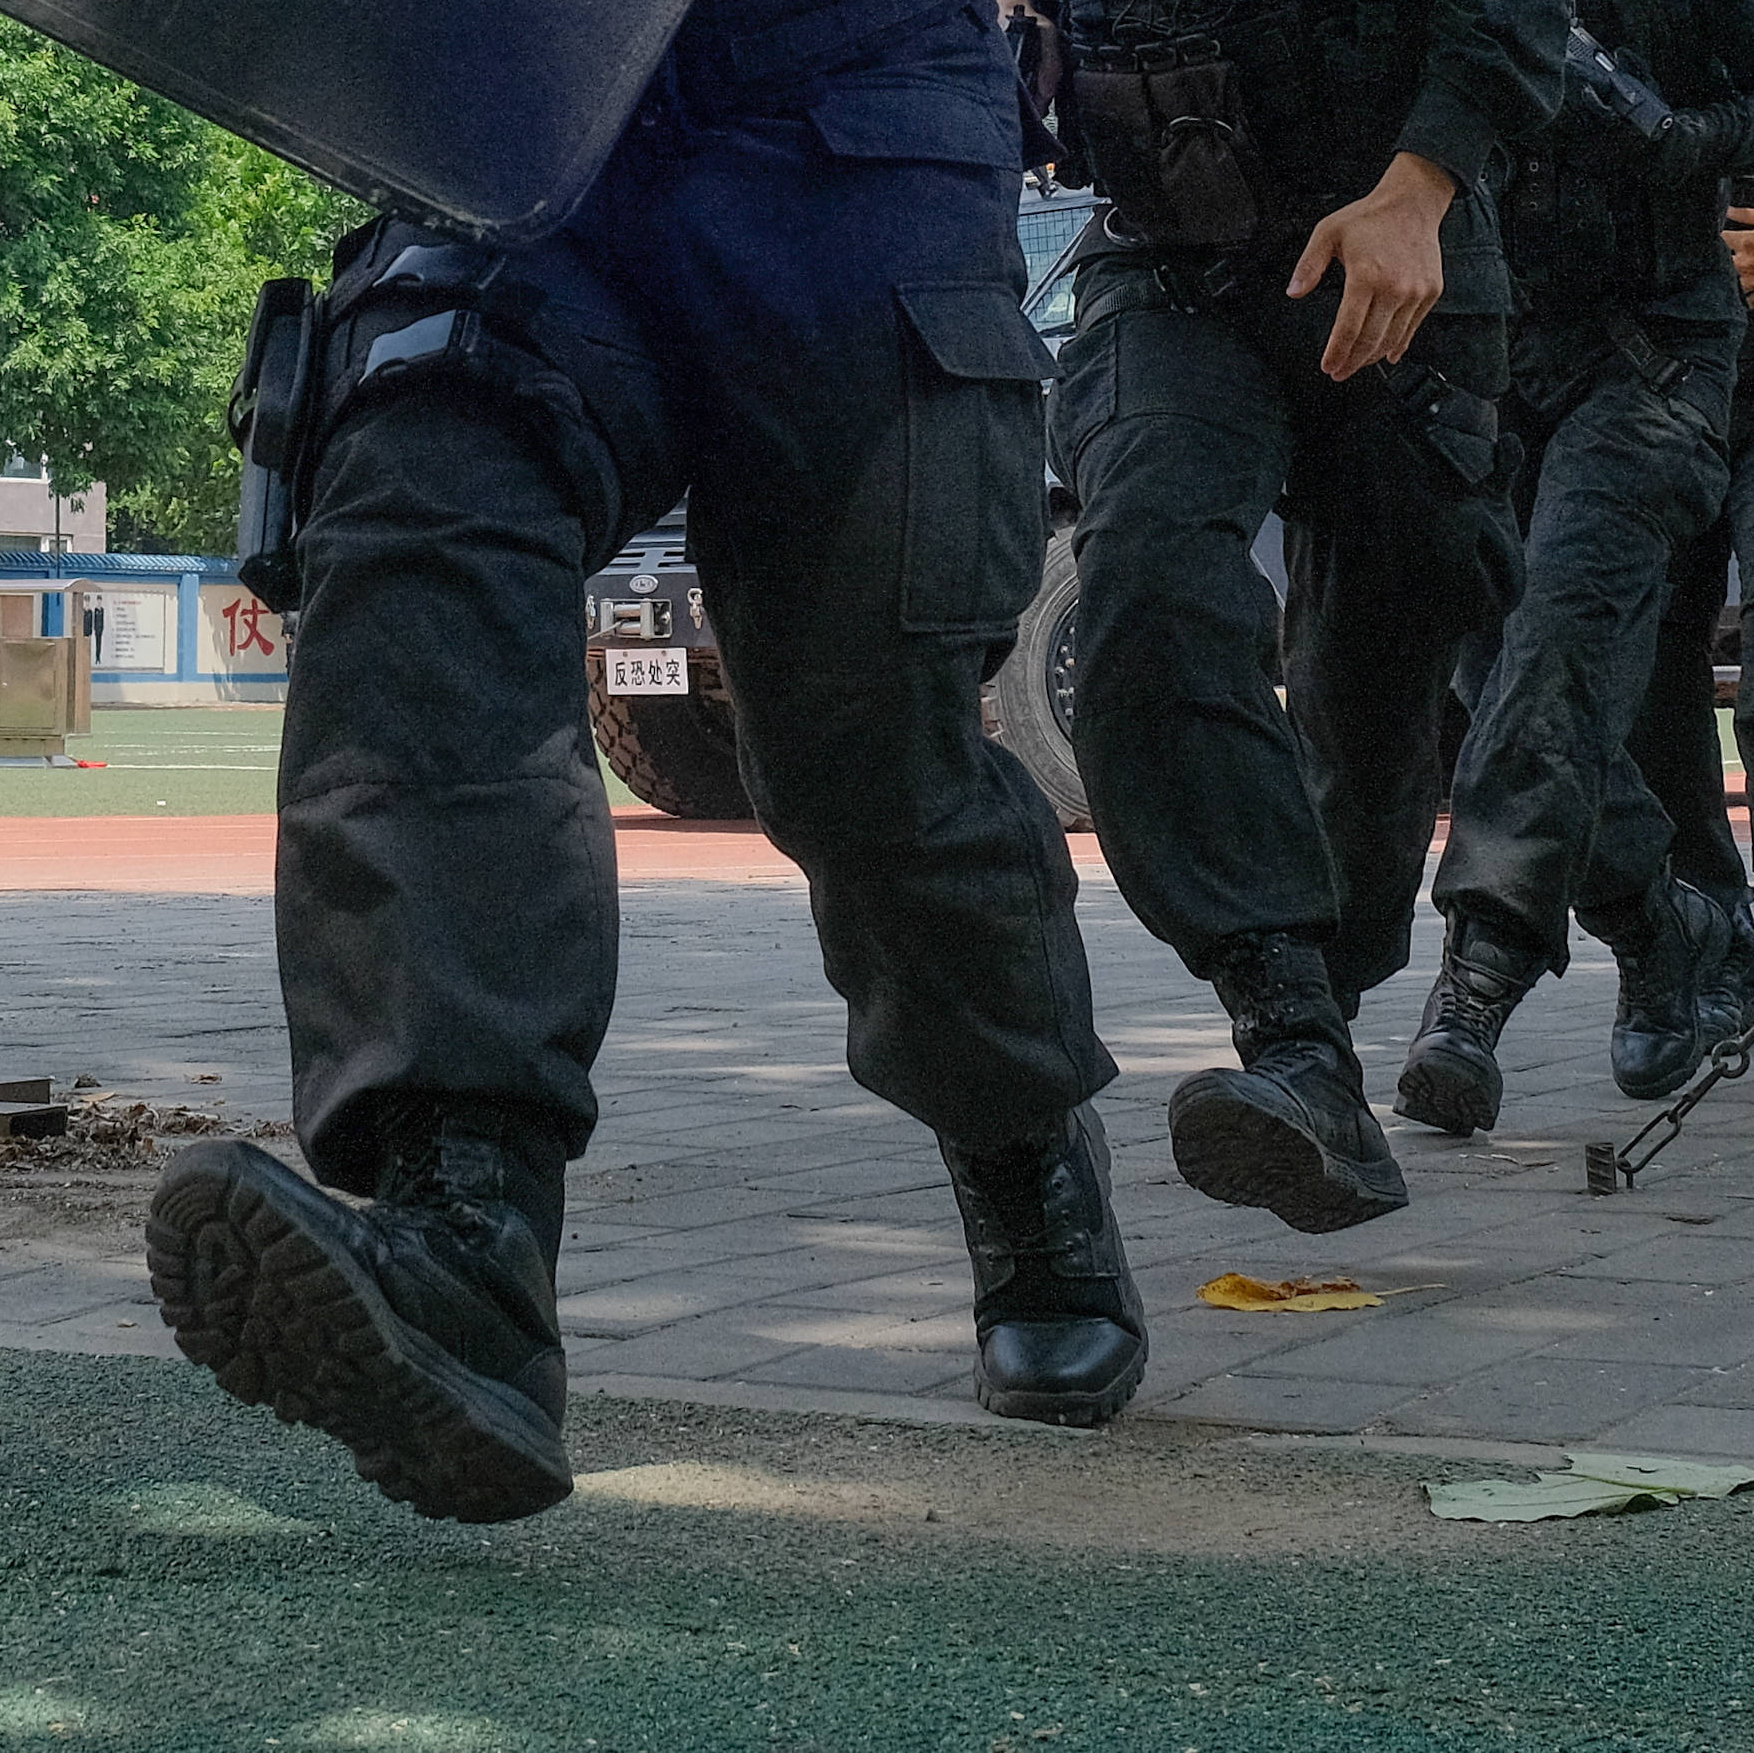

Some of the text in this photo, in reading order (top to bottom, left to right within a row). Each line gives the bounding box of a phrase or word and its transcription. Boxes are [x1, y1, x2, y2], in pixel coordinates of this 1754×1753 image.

[222, 598, 275, 657] 仗
[614, 659, 681, 687] 反恐处突
